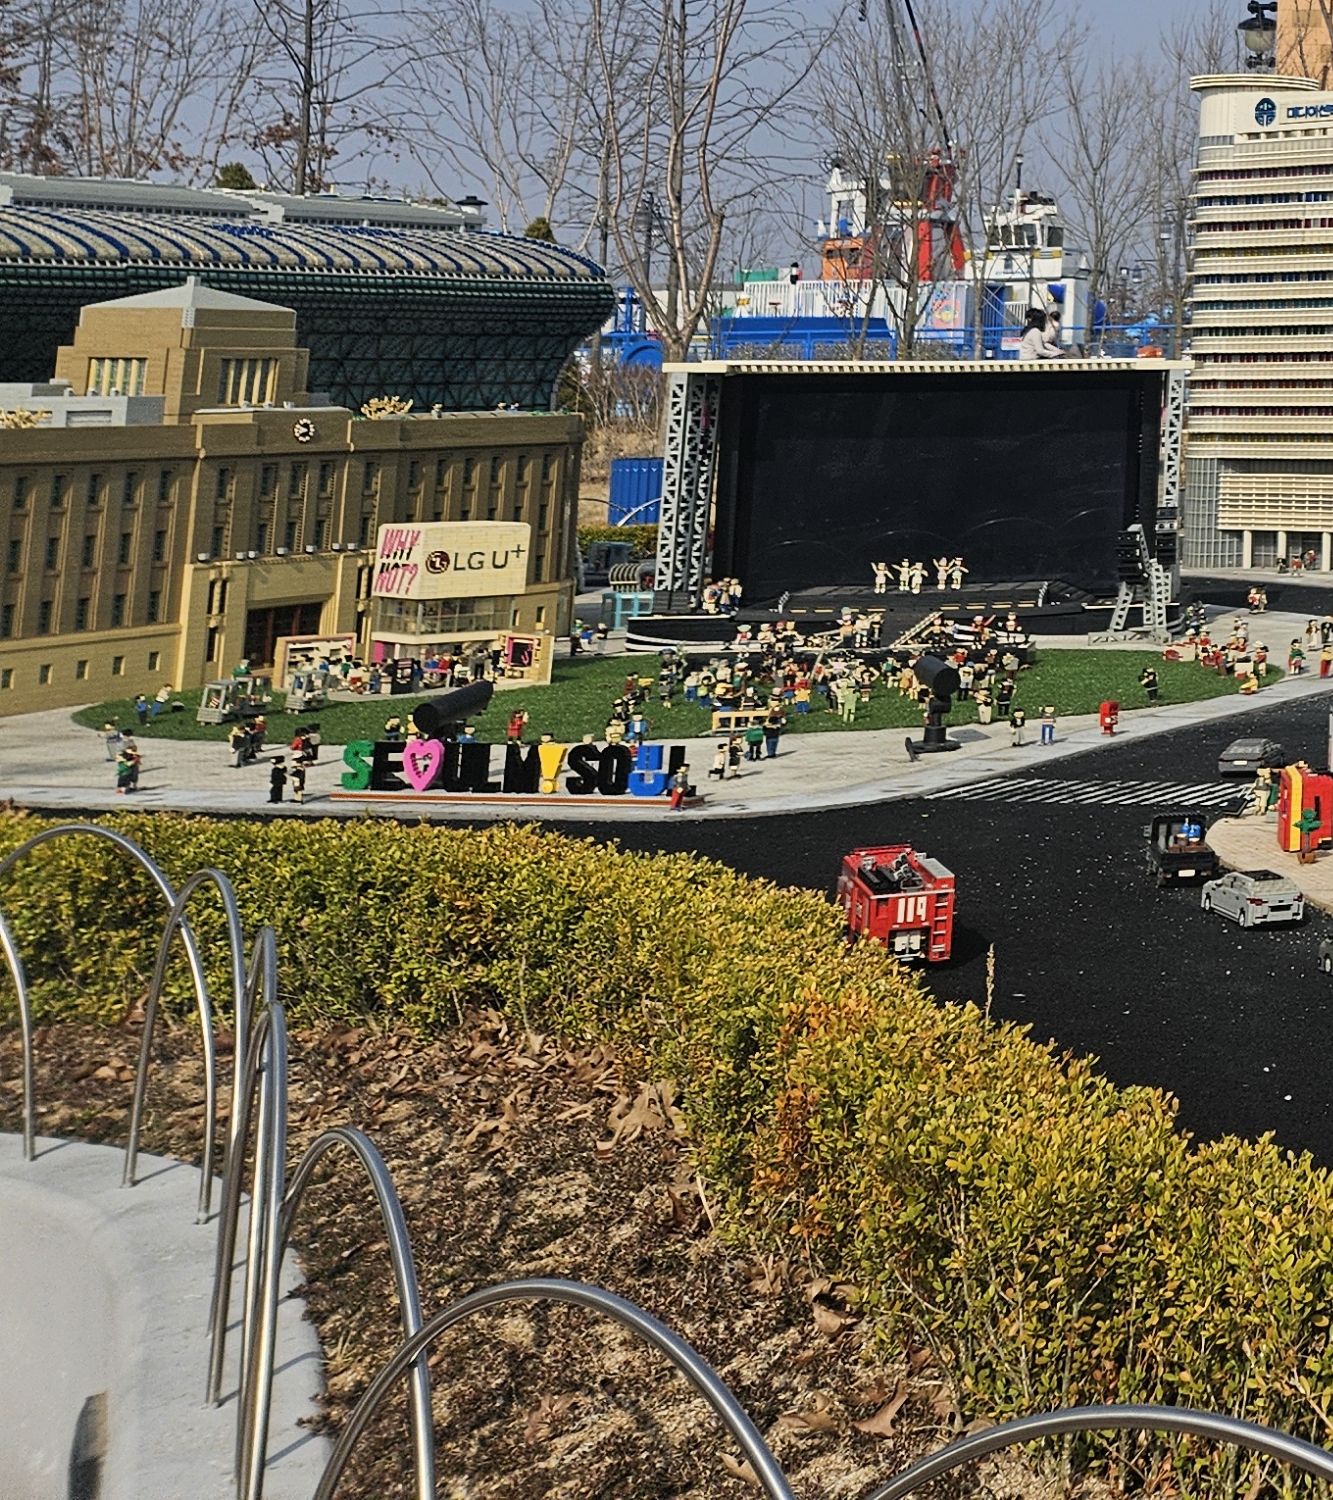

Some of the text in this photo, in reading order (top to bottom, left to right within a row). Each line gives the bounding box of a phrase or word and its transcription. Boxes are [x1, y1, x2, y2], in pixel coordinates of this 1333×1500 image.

[453, 551, 486, 572] LG
[373, 562, 419, 595] NOT?
[896, 896, 928, 924] 119
